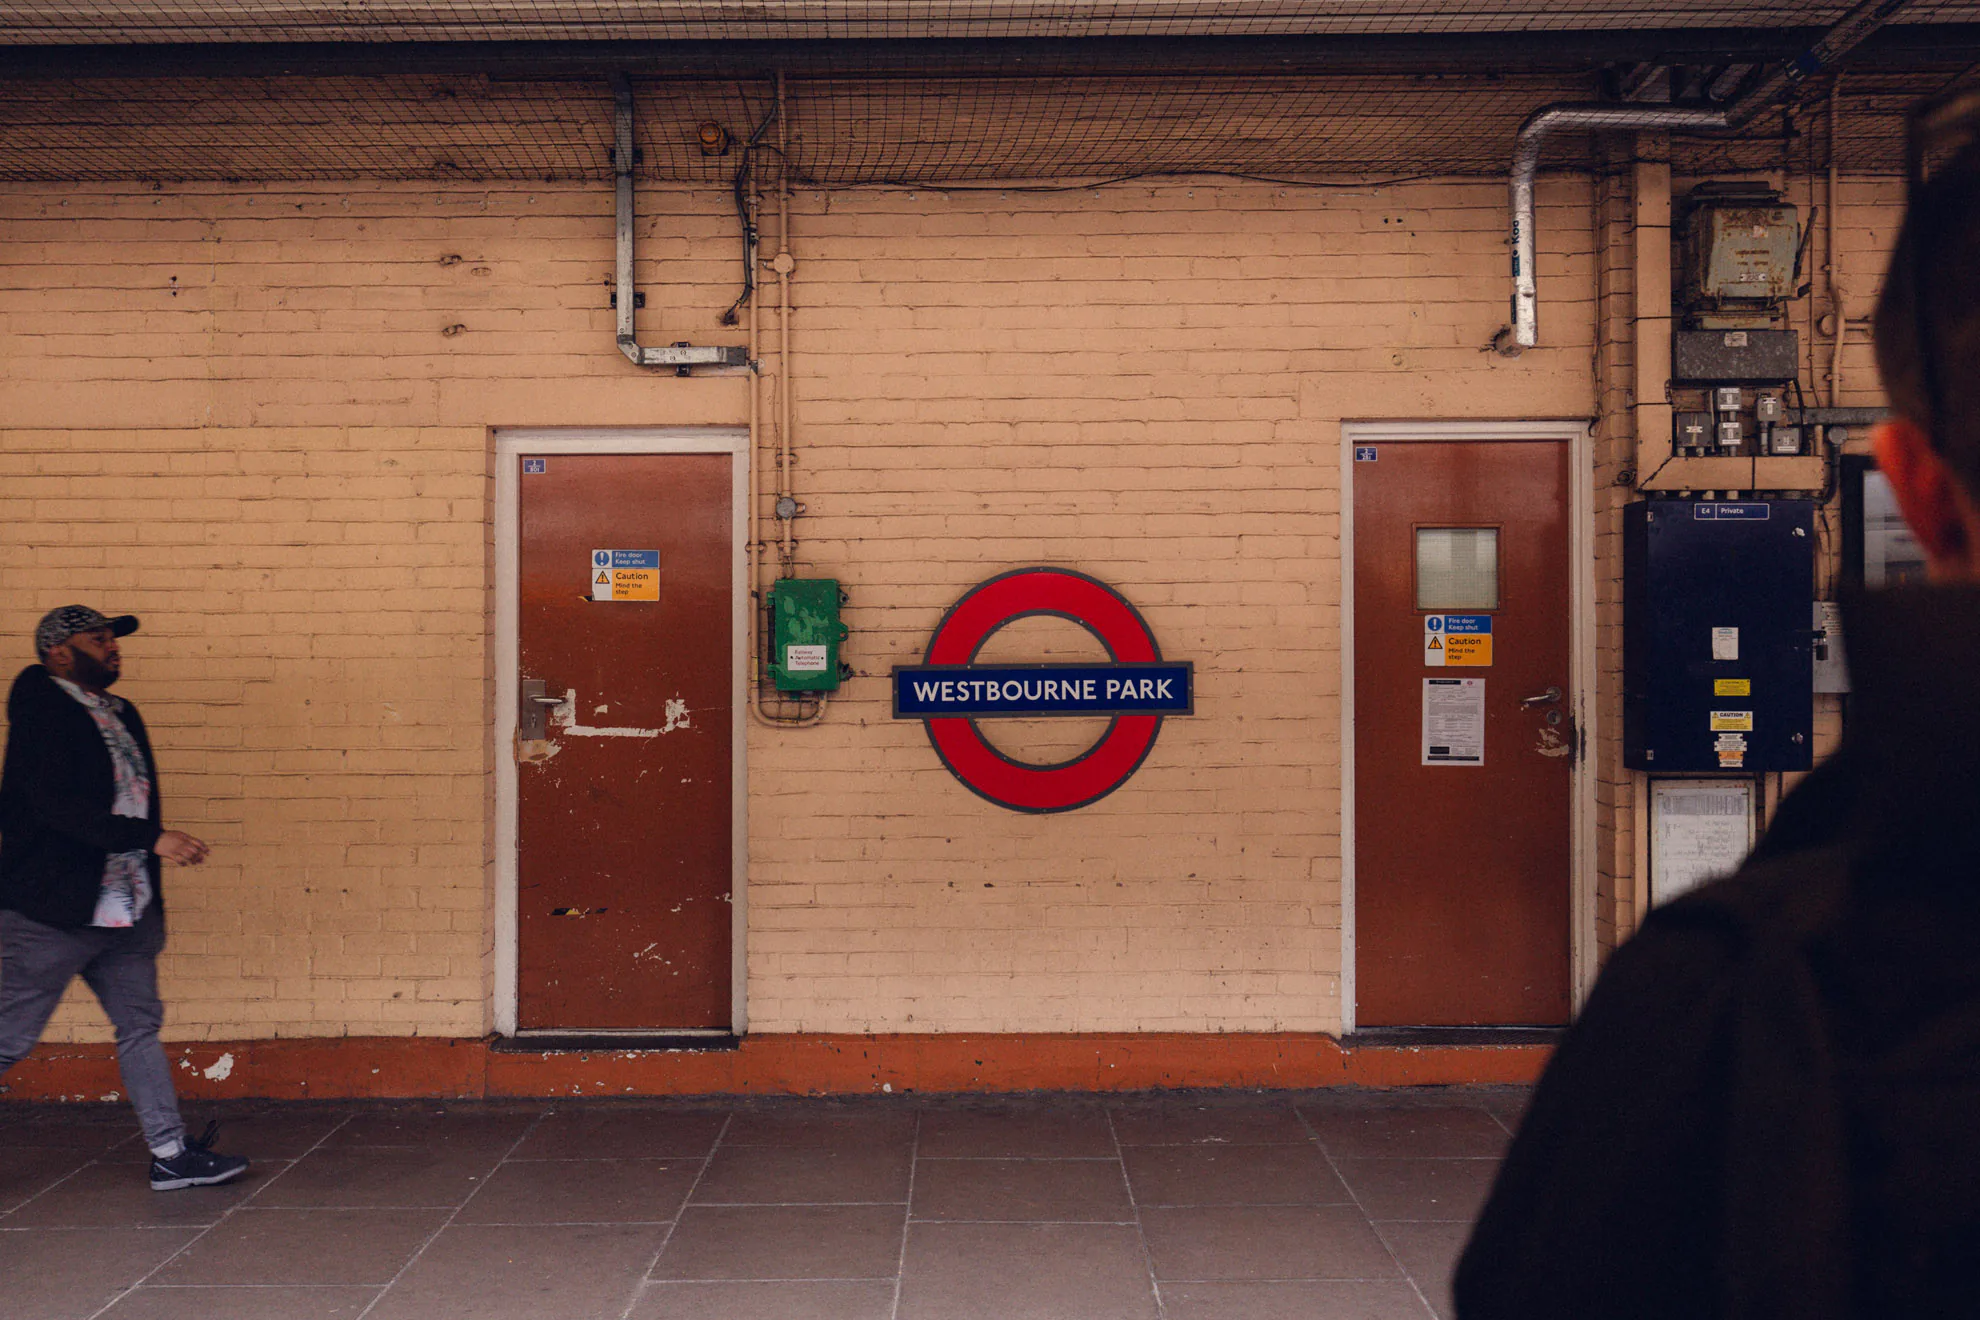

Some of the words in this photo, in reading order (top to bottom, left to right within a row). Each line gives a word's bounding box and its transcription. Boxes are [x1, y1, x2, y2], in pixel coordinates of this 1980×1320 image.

[615, 572, 649, 580] Caution
[1448, 637, 1482, 645] Caution
[913, 680, 1097, 702] WESTBOURNE
[1106, 678, 1174, 700] PARK
